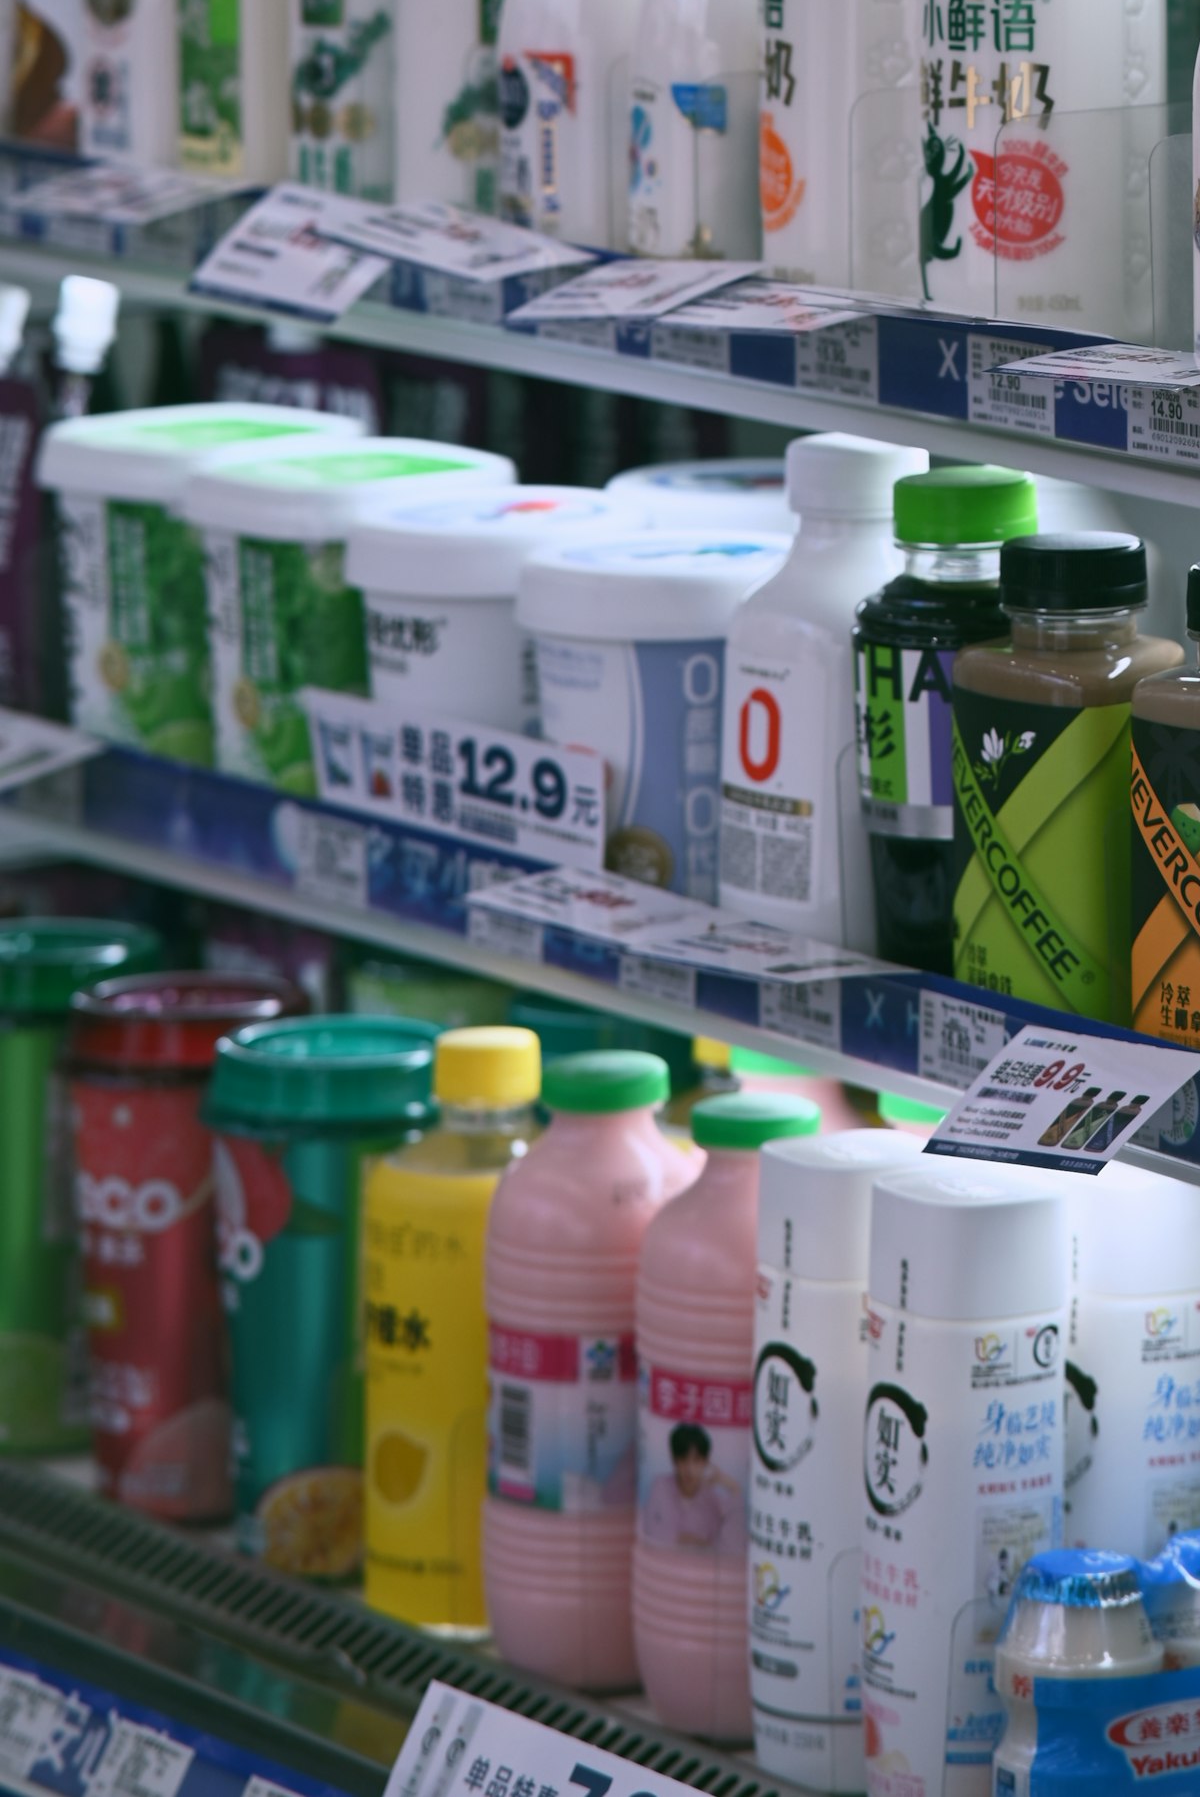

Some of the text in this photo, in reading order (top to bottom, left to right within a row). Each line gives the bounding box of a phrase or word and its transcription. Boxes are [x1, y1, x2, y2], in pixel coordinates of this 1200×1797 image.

[1150, 401, 1182, 420] 14.90
[458, 735, 599, 828] 12.9元
[1160, 981, 1190, 1007] 冷萃
[990, 1059, 1092, 1094] 单品特惠9.9元
[765, 1366, 792, 1453] 如实
[873, 1404, 903, 1496] 如实
